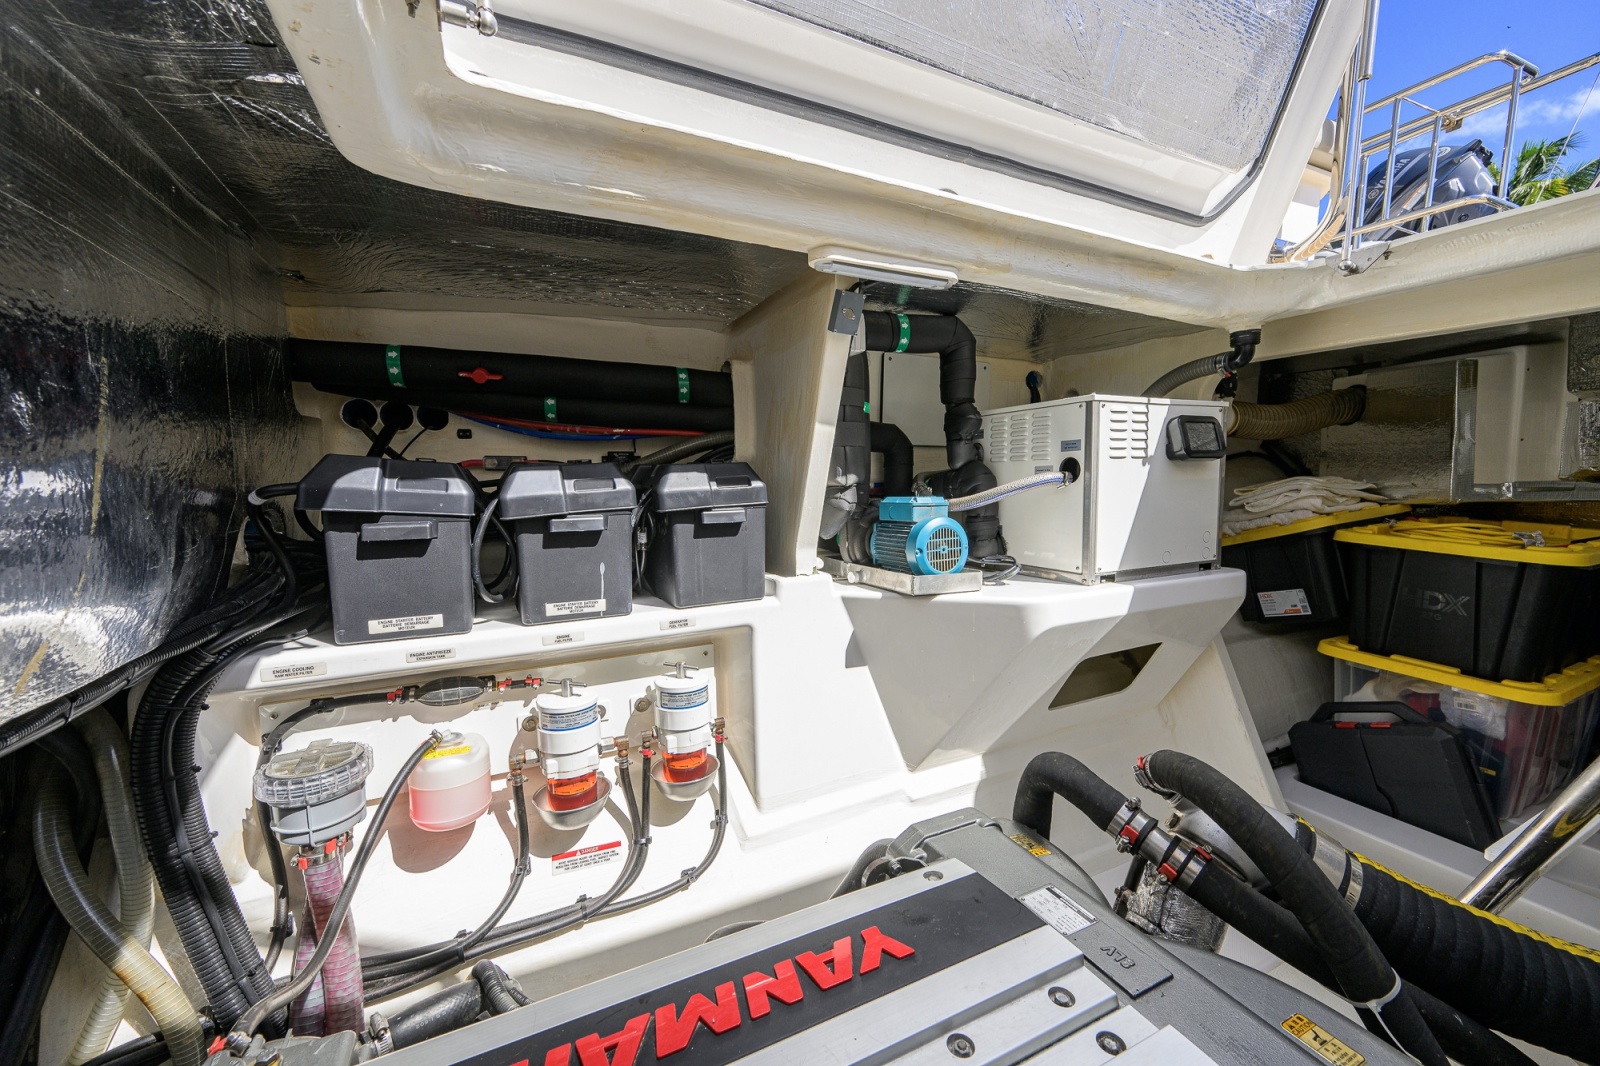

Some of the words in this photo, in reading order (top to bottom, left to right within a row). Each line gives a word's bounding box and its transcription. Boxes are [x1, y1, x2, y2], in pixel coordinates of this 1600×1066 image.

[1374, 158, 1410, 189] YAAHA
[508, 925, 916, 1066] YANMA
[1292, 1020, 1313, 1036] CAUTION
